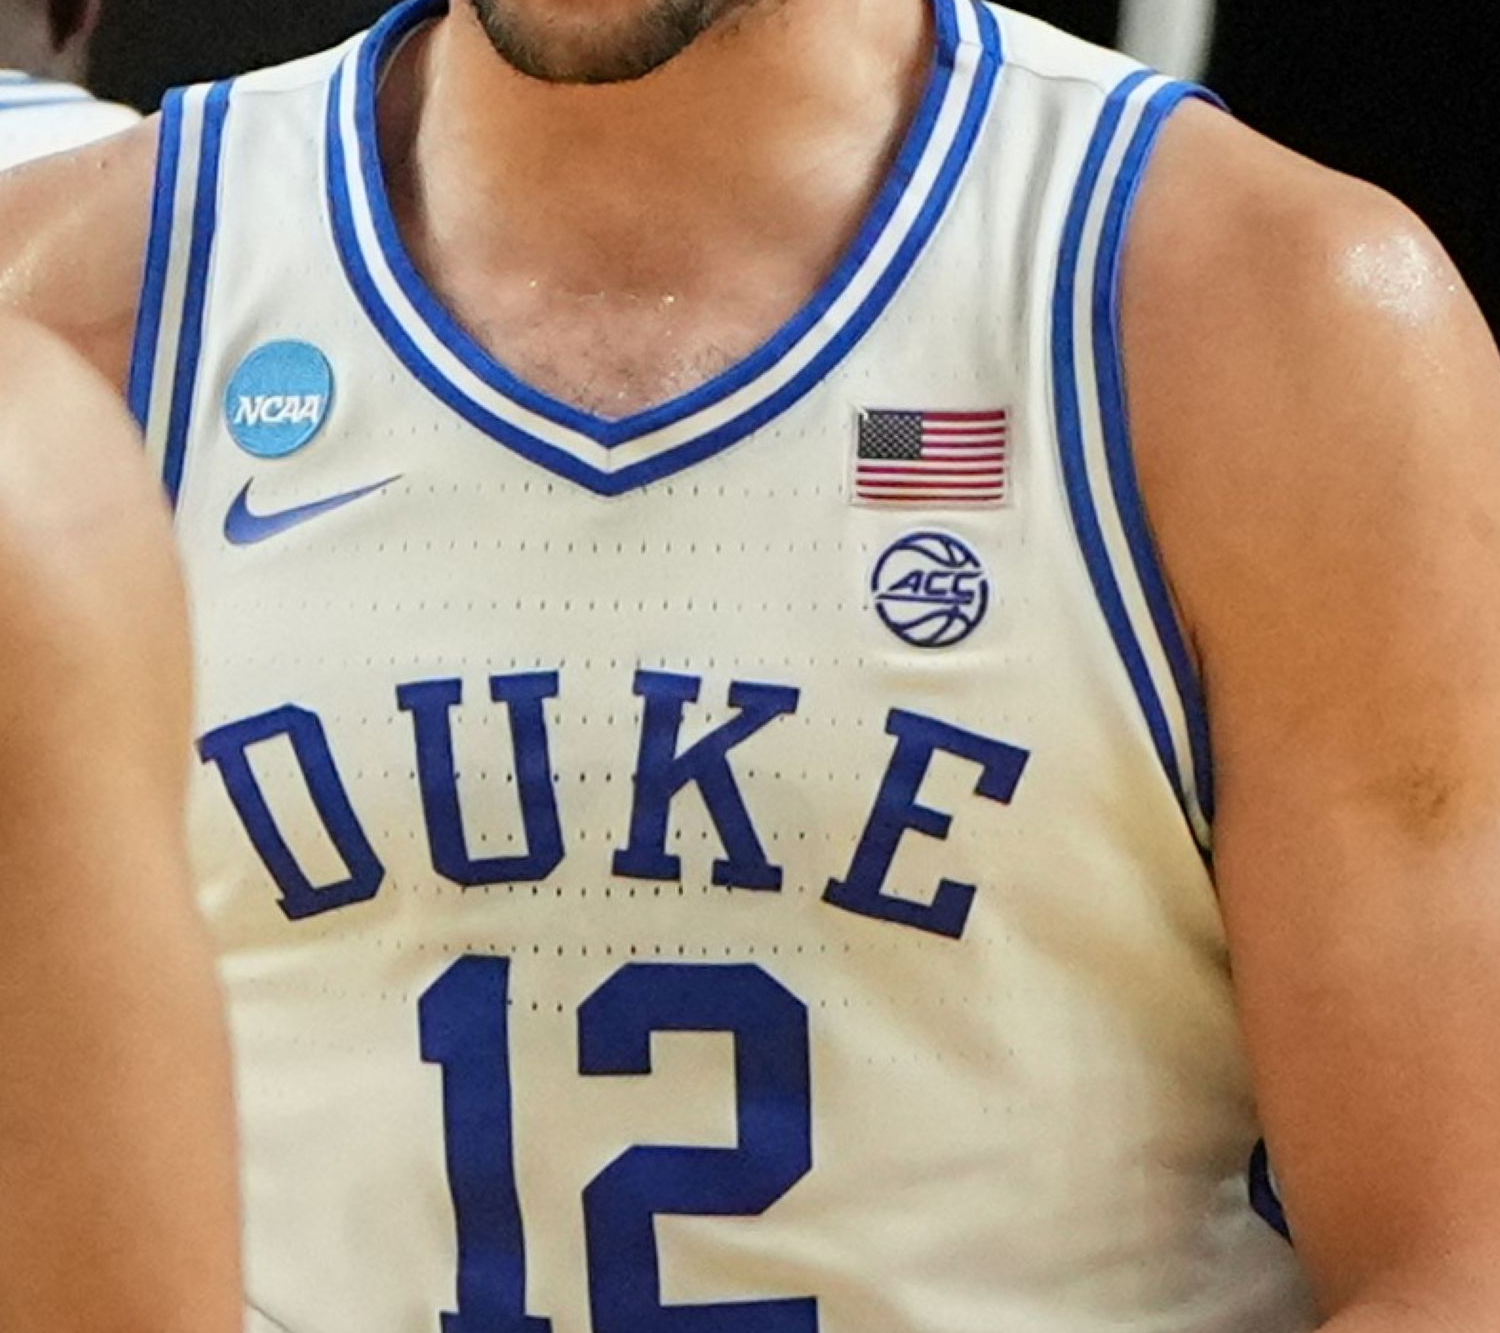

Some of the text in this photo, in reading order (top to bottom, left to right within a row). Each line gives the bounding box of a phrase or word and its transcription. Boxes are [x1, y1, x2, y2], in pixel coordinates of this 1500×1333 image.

[233, 394, 321, 427] NCAA
[888, 570, 982, 604] ACC
[196, 670, 1030, 940] DUKE
